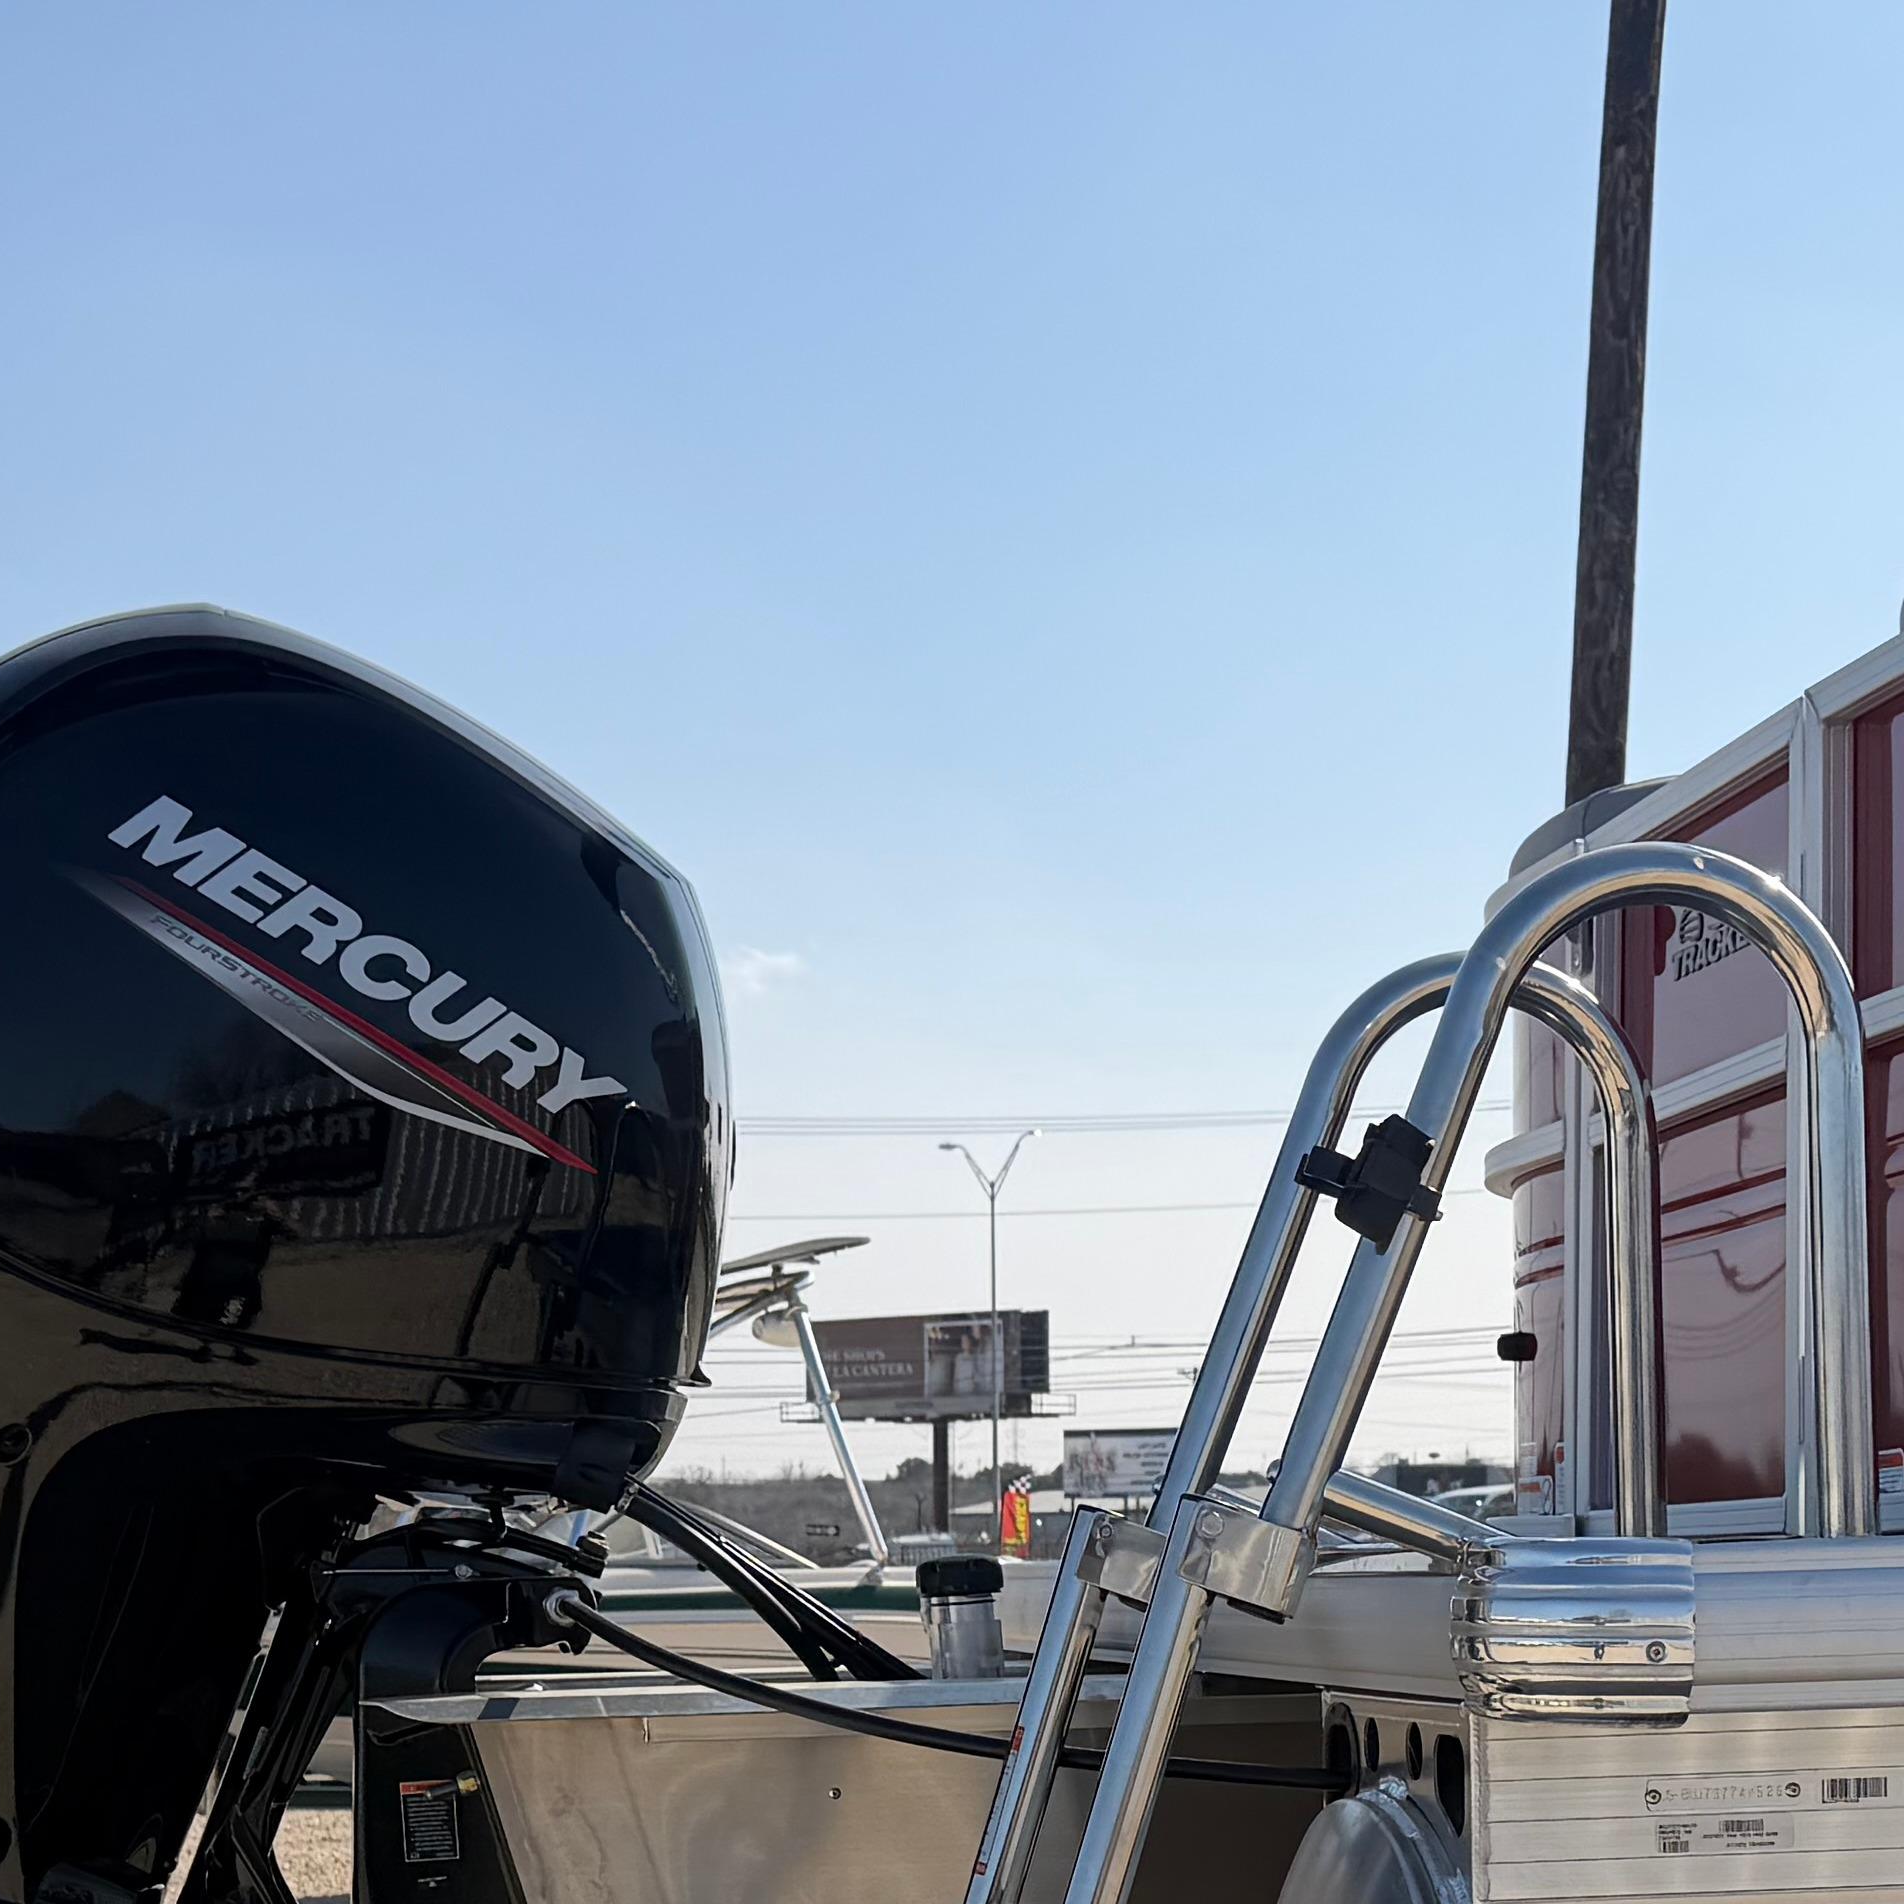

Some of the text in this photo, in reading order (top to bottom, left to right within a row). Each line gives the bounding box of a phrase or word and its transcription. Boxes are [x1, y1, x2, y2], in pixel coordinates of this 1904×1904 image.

[107, 795, 628, 1115] MERCURY
[150, 914, 322, 1023] FOURSTROKE
[1672, 927, 1751, 982] TRACKE
[851, 1362, 914, 1377] CANTERA
